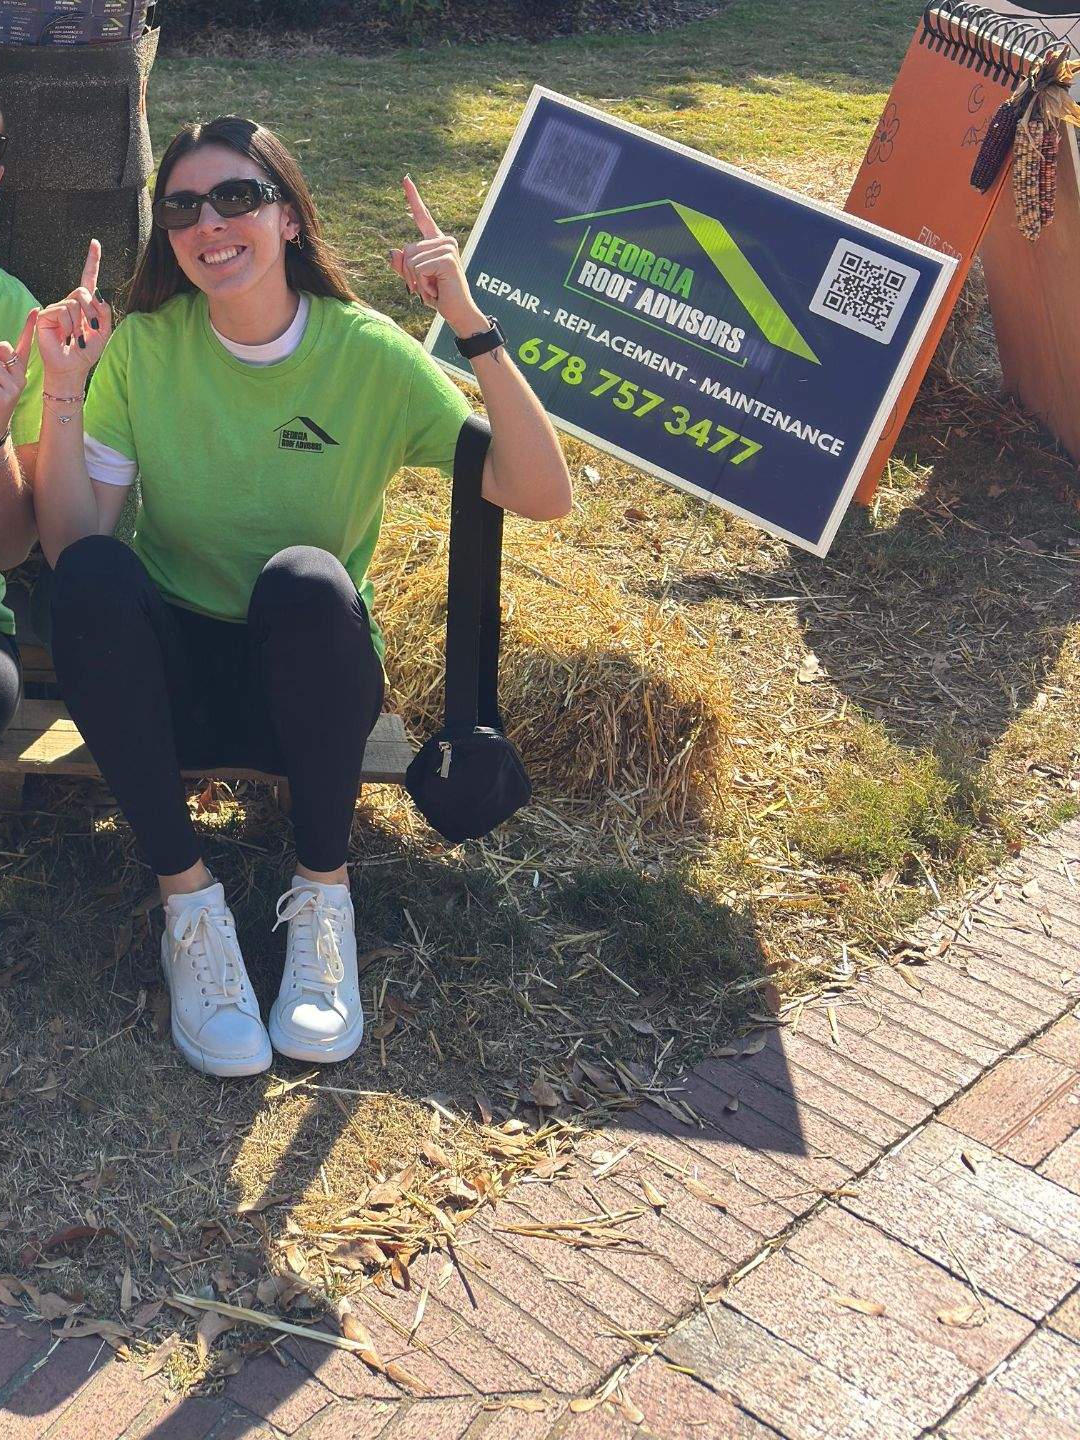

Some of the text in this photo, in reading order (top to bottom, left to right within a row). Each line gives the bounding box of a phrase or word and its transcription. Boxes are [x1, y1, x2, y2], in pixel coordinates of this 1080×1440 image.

[577, 260, 746, 354] ROOF ADVISORS
[589, 230, 694, 299] GEORGIA
[476, 272, 540, 314] REPAIR
[554, 308, 688, 382] REPLACEMENT
[700, 378, 846, 458] MAINTENANCE
[518, 337, 764, 466] 678 757 3477
[282, 430, 308, 441] GEORGIA
